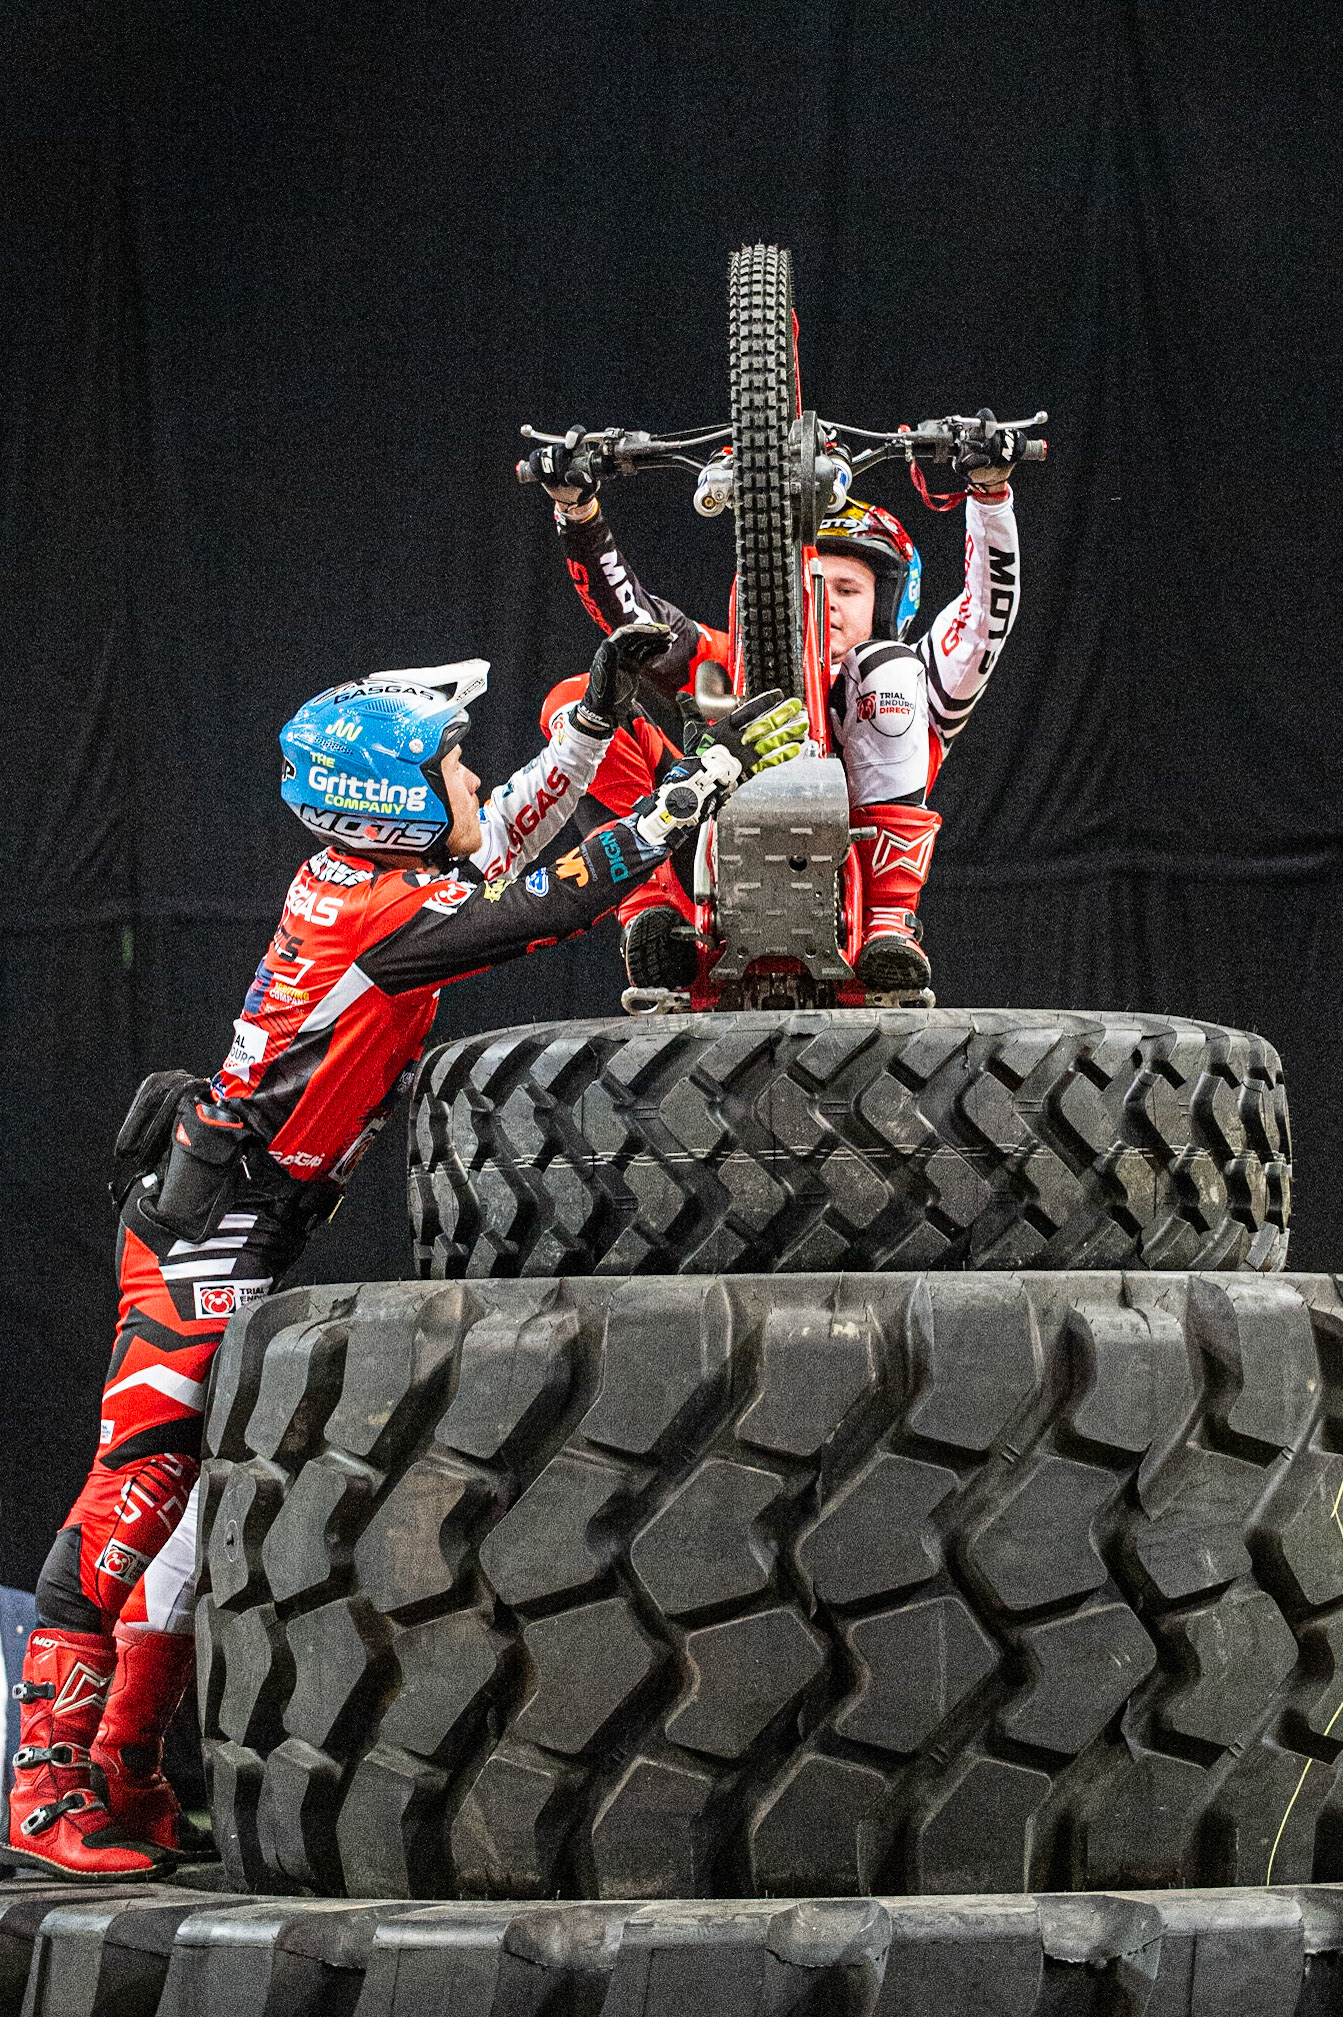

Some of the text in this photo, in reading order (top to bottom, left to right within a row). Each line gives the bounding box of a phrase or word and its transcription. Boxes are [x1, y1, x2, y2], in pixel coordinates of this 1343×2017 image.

[820, 518, 857, 530] OTS
[333, 685, 434, 705] GASGAS
[880, 692, 905, 700] TRIAL
[879, 707, 911, 716] DIRECT
[880, 700, 915, 710] ENDURO
[310, 751, 336, 768] THE
[308, 766, 429, 812] Gritting
[324, 793, 405, 815] COMPANY
[300, 803, 443, 848] MOTS
